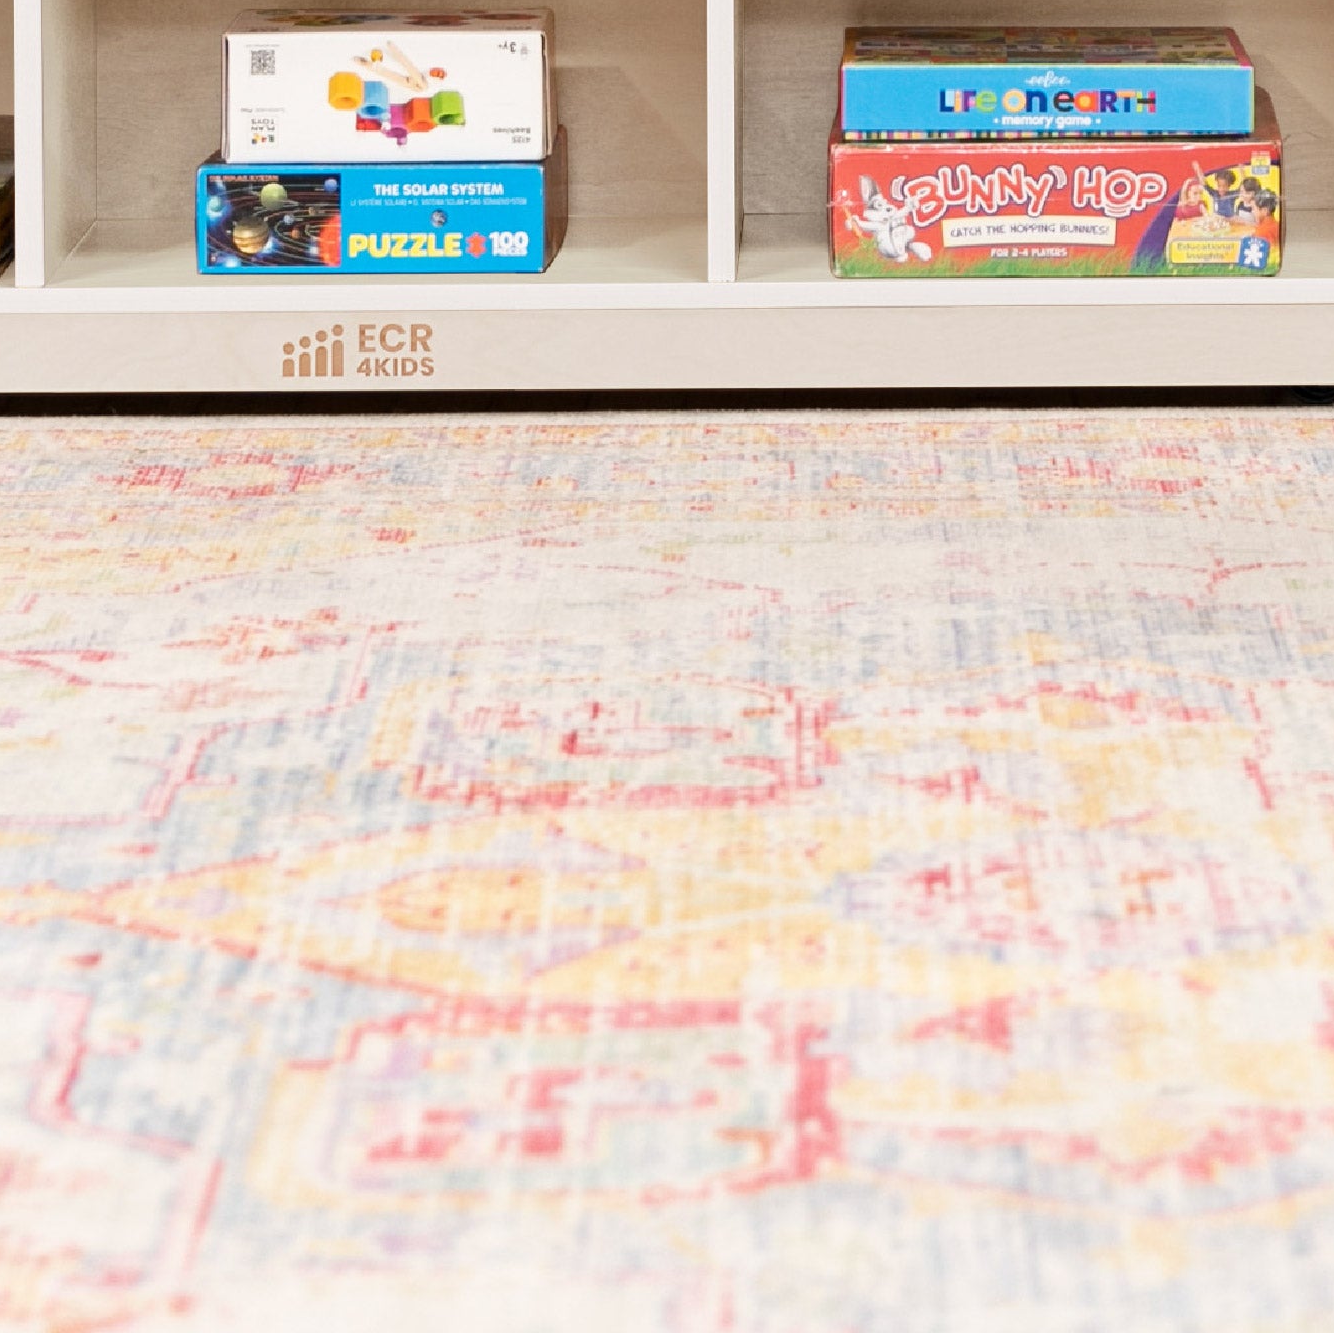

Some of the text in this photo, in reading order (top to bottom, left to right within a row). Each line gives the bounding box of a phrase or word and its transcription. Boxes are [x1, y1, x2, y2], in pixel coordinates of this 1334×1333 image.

[1002, 89, 1048, 113] on
[1002, 116, 1092, 129] memory game
[373, 182, 504, 196] THE SOLAR SYSTEM
[905, 164, 1168, 227] BUNNY HOP
[950, 223, 1110, 238] CATCH THE HOPPING BUNNIES!
[348, 231, 530, 258] PUZZLE 100
[358, 323, 434, 353] ECR
[356, 357, 435, 377] 4KIDS
